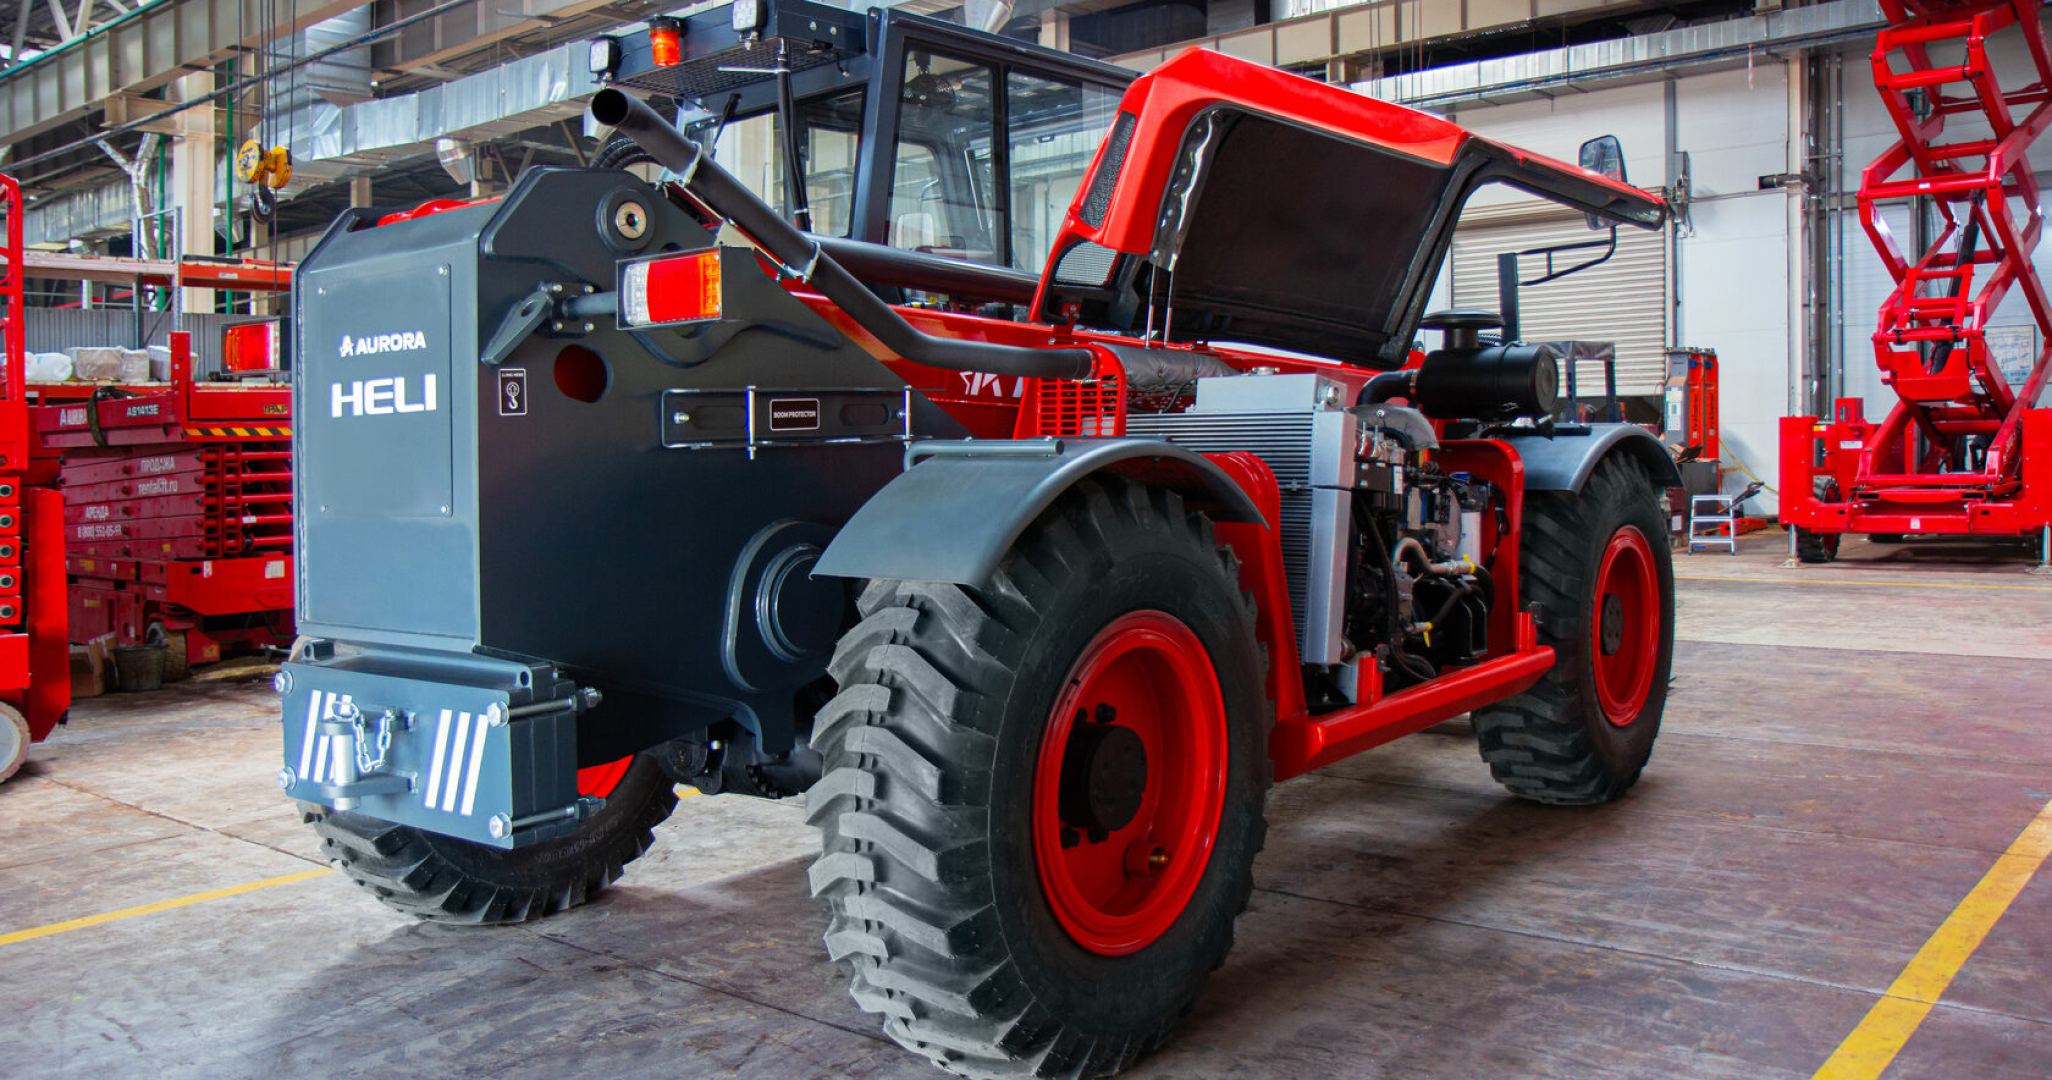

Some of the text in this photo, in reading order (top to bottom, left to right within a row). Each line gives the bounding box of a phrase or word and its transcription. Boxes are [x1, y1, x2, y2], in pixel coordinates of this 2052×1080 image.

[355, 330, 427, 356] AURORA
[331, 373, 437, 418] HELI
[126, 403, 160, 418] AS1413E
[773, 410, 817, 419] BOOM PROTECTOR
[141, 456, 175, 474] ПРОДАЖА
[85, 505, 109, 521] АРЕНДА
